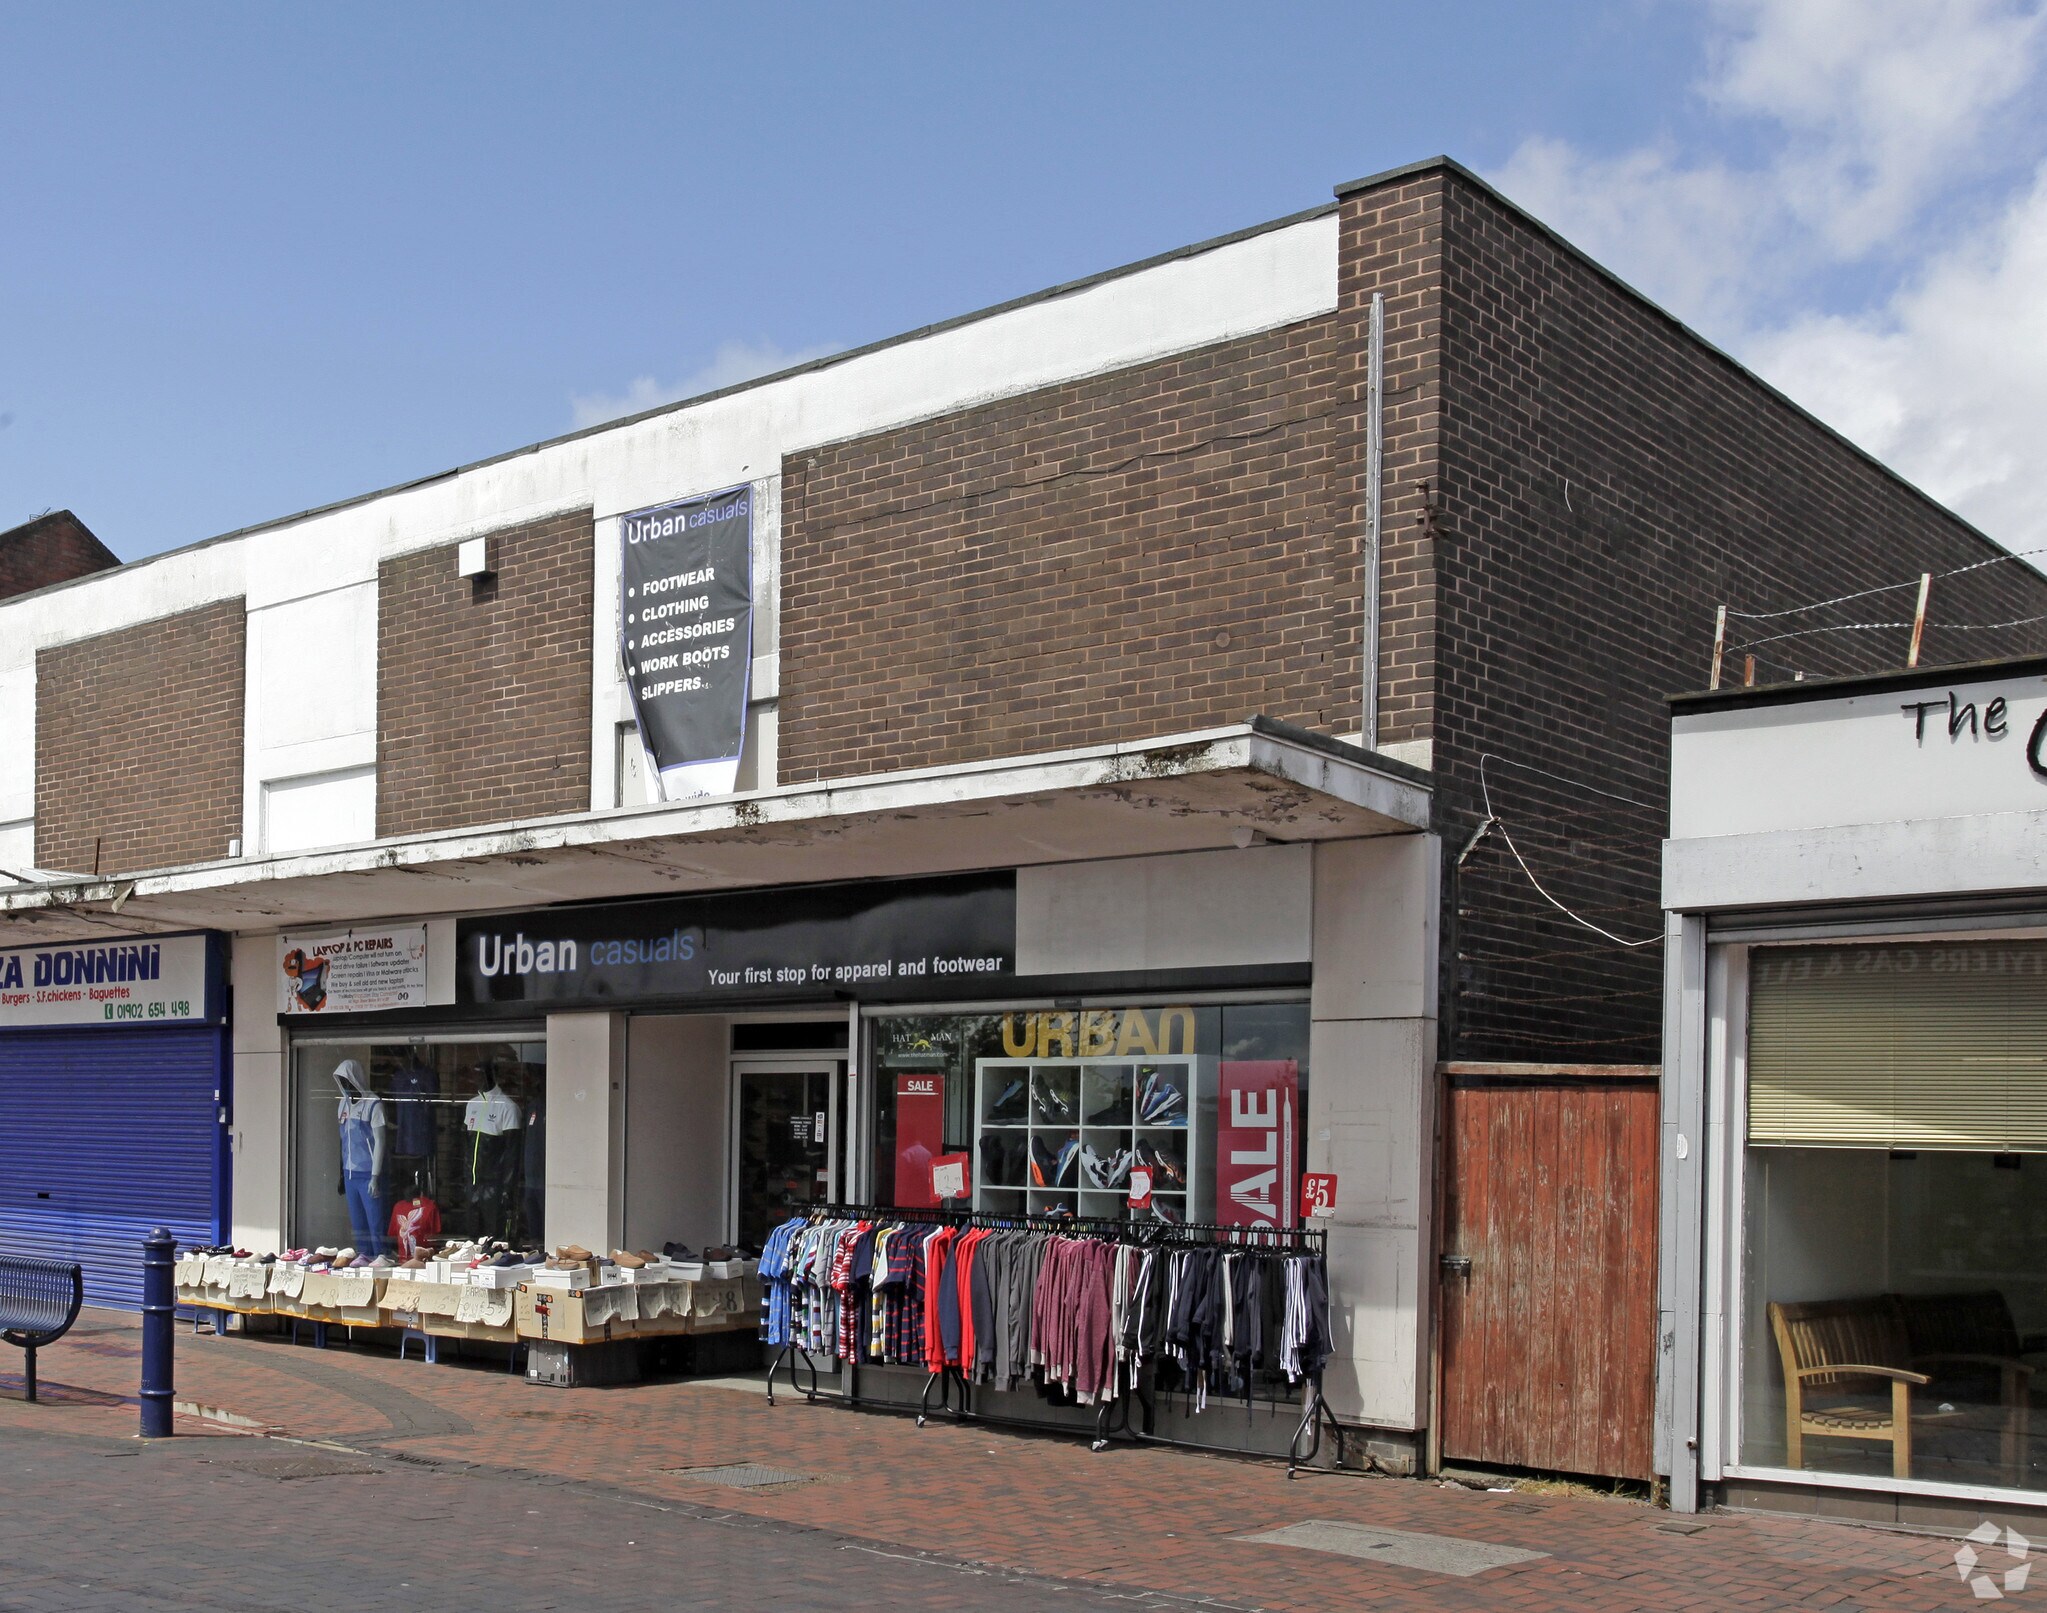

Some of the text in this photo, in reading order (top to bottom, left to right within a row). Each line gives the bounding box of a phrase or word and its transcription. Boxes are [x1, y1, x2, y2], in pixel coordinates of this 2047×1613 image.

[628, 498, 748, 545] Urban casuals
[642, 567, 715, 596] FOOTWEAR
[642, 596, 709, 622] CLOTHING
[641, 618, 735, 649] ACCESSORIES
[641, 645, 730, 674] WORK BOOTS
[641, 676, 702, 700] SLIPPERS
[1901, 691, 2007, 739] The
[312, 937, 393, 957] LAPTOP & PC REPAIRS
[479, 928, 694, 977] Urban casuals
[0, 955, 23, 989] A
[339, 980, 348, 989] buy
[708, 956, 1002, 985] Your first stop for apparel and footwear
[89, 986, 130, 1002] Baguettes
[117, 1001, 190, 1019] 01902 654 498
[892, 1032, 952, 1042] HAT MAN
[907, 1080, 933, 1091] SALE
[1305, 1178, 1329, 1208] £5
